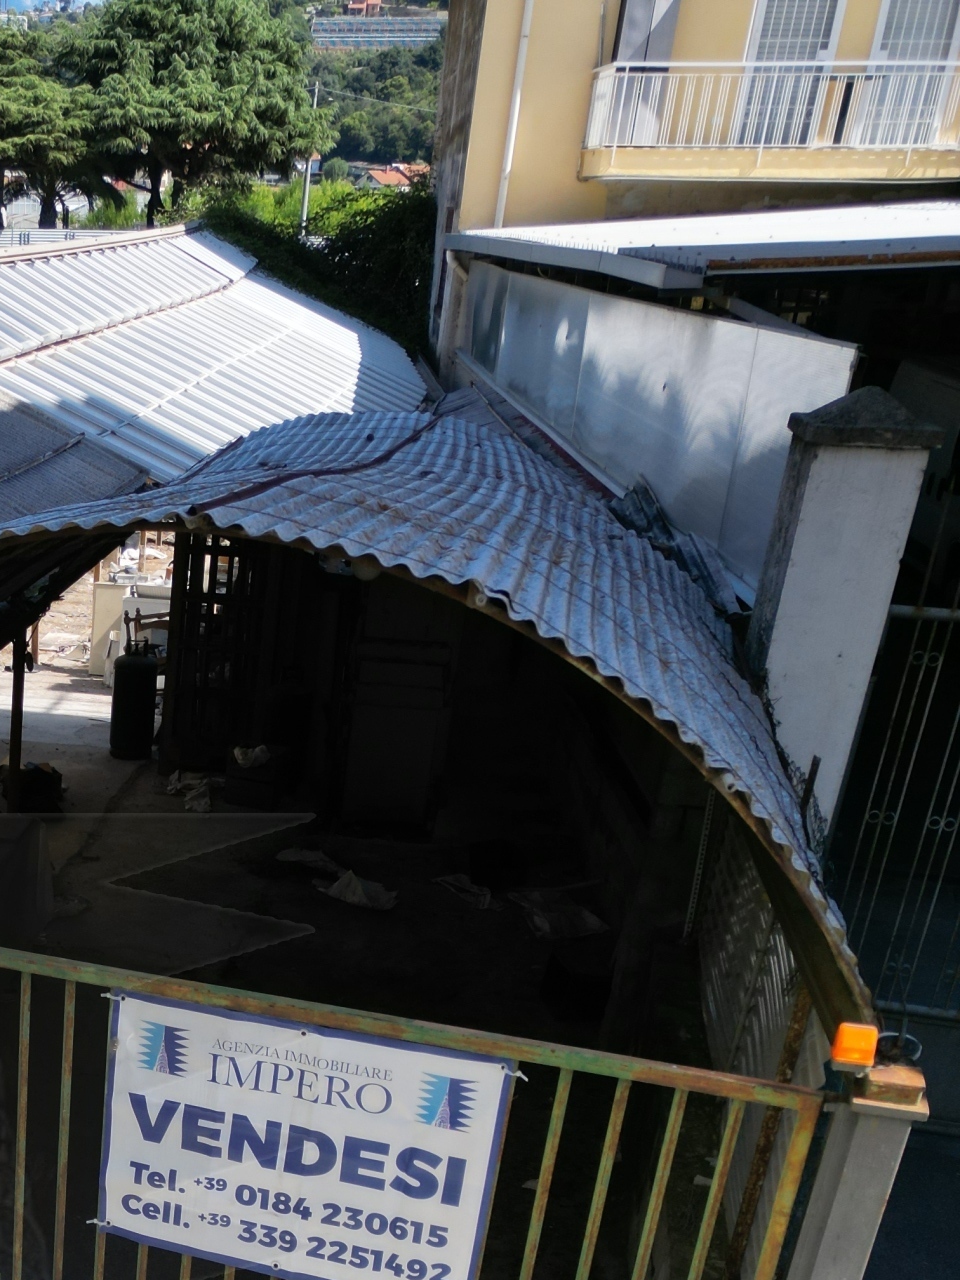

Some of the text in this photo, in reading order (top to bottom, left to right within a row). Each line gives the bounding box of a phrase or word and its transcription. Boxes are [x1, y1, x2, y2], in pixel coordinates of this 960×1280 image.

[207, 1053, 392, 1114] IMPERO
[212, 1038, 392, 1081] AGENZIA IMMOBILIARE
[128, 1092, 467, 1207] VENDESI
[122, 1194, 190, 1229] Cell.
[198, 1212, 231, 1228] +39
[237, 1220, 298, 1253] 339
[130, 1161, 449, 1248] Tel. +39 0184 230615
